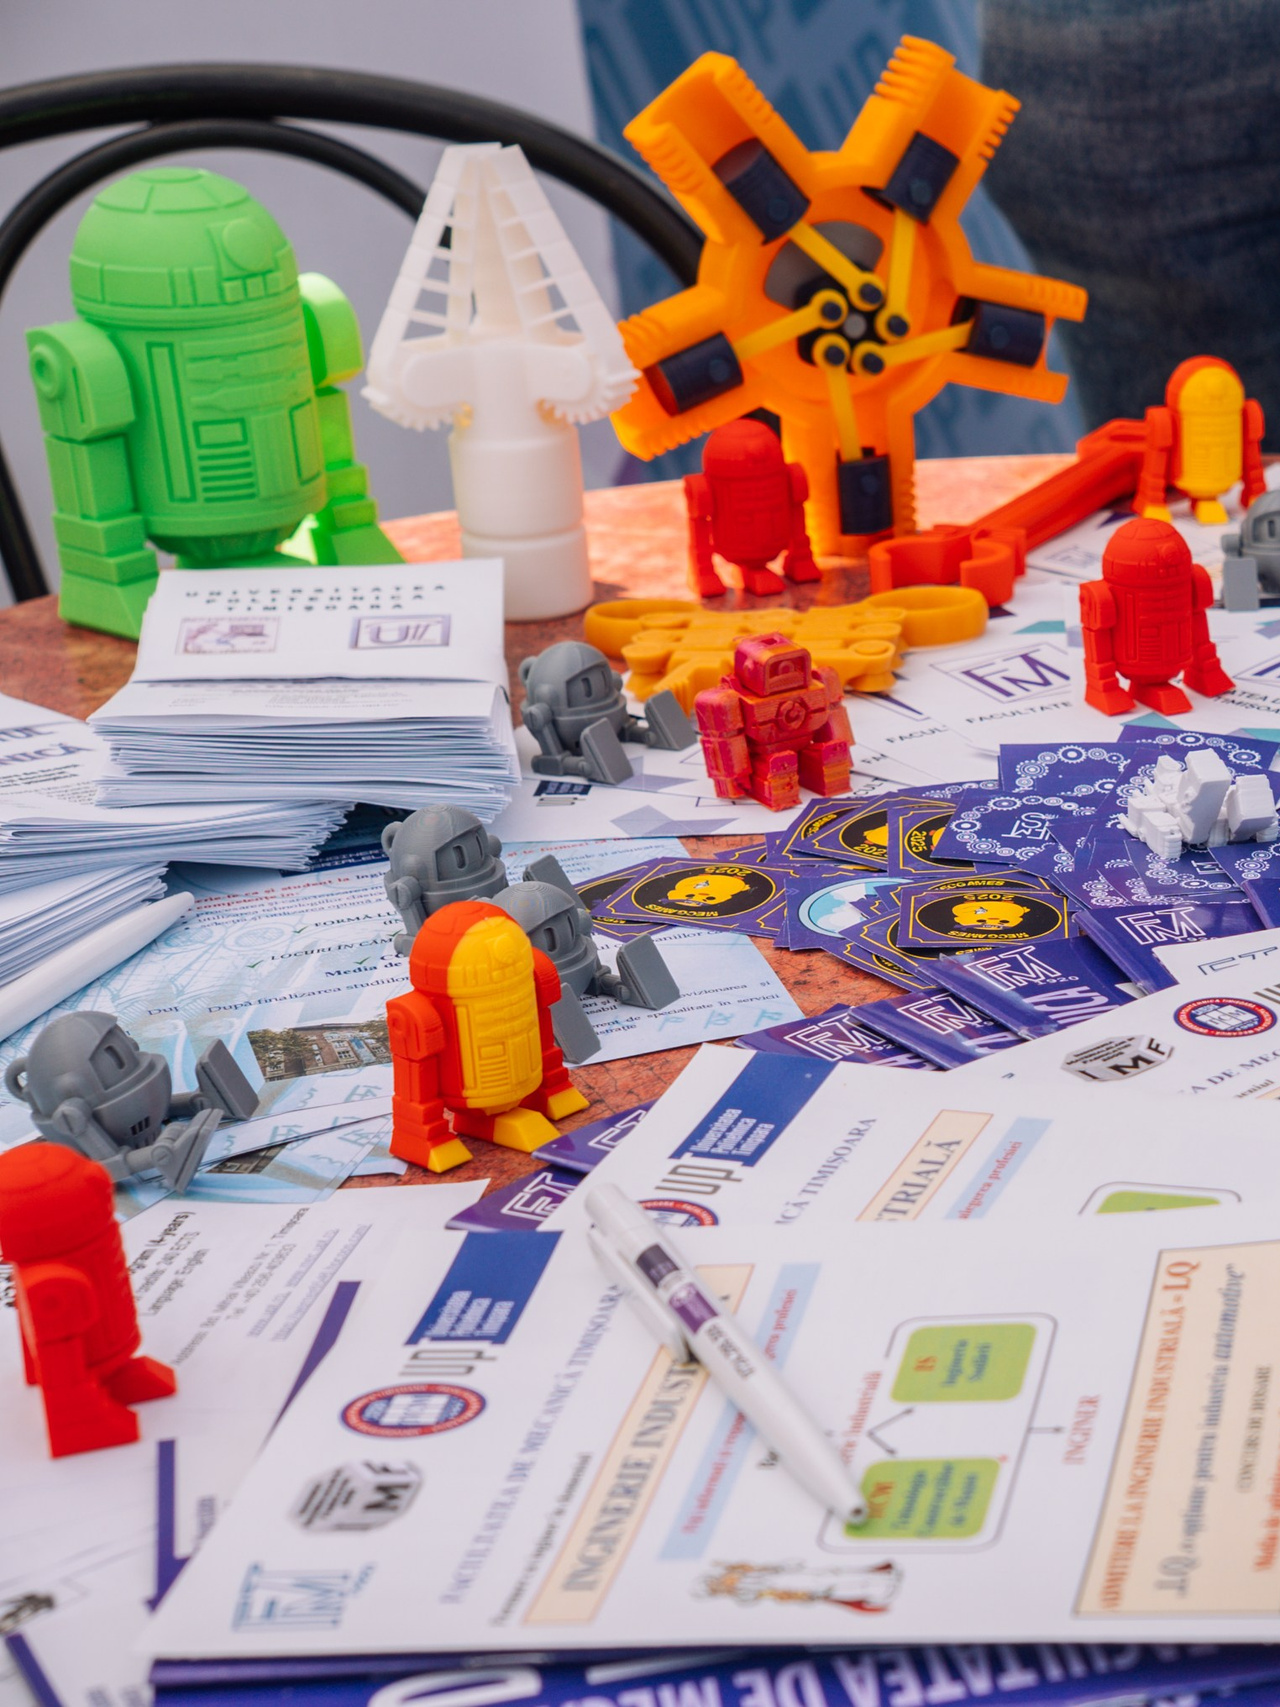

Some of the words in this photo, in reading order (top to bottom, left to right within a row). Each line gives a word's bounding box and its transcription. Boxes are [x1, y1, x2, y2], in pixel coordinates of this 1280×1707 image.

[911, 830, 927, 852] 2025
[947, 930, 1030, 940] MECGAMES
[271, 946, 332, 961] LOCURI
[325, 964, 378, 978] Media
[384, 960, 402, 969] de
[257, 985, 343, 1007] finalizarea
[625, 1014, 642, 1024] de
[647, 1001, 714, 1020] specialitate
[737, 993, 782, 1005] servicii
[1207, 1066, 1241, 1086] DE
[803, 1117, 877, 1199] TIMIȘOARA
[1161, 1259, 1200, 1293] LQ
[562, 1452, 656, 1593] INGINERIE
